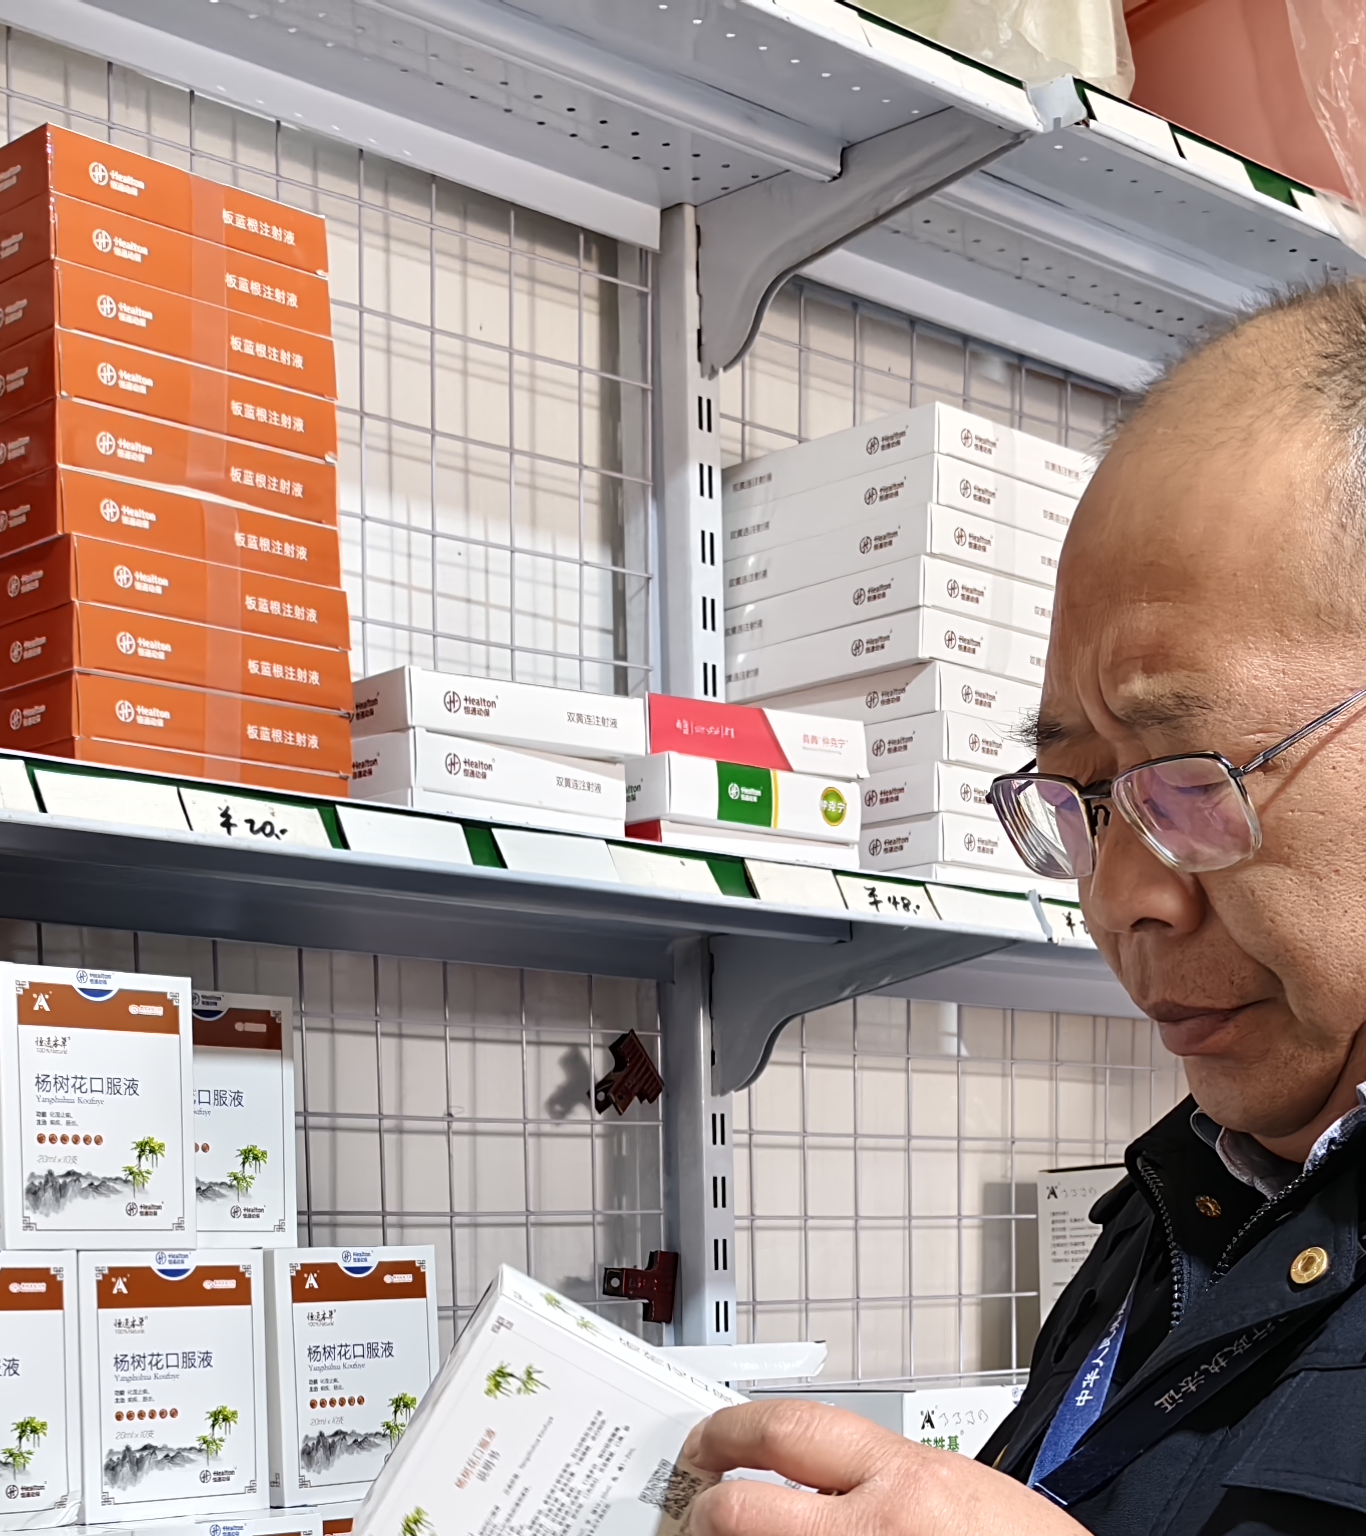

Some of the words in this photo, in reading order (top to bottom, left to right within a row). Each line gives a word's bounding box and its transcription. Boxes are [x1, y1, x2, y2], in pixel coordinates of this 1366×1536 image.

[108, 170, 146, 191] Healton
[222, 208, 296, 246] 板蓝根注射液
[112, 235, 149, 255] Healton
[225, 273, 299, 308] 板蓝根注射液
[117, 301, 153, 320] Healton
[229, 336, 304, 370] 板蓝根注射液
[117, 368, 154, 387] Healton
[230, 401, 305, 432] 板蓝根注射液
[116, 437, 153, 456] Healton
[229, 467, 304, 498] 板蓝根注射液
[120, 505, 157, 523] Healton
[234, 532, 308, 561] 板蓝根注射液
[133, 571, 169, 588] Healton
[245, 595, 319, 623] 板蓝根注射液
[135, 637, 172, 654] Healton
[247, 659, 321, 685] 板蓝根注射液
[464, 695, 497, 710] Healton
[134, 705, 170, 721] Healton
[567, 711, 618, 729] 双黄连注射液
[246, 724, 320, 750] 板蓝根注射液
[463, 758, 494, 772] Healton
[556, 775, 602, 793] 双黄连注射液
[880, 787, 905, 797] Healton
[884, 836, 909, 847] Healton
[35, 1072, 140, 1097] 杨树花口服液
[193, 1088, 244, 1108] 口服液
[307, 1342, 395, 1361] 杨树花口服液
[113, 1351, 213, 1373] 杨树花口服液
